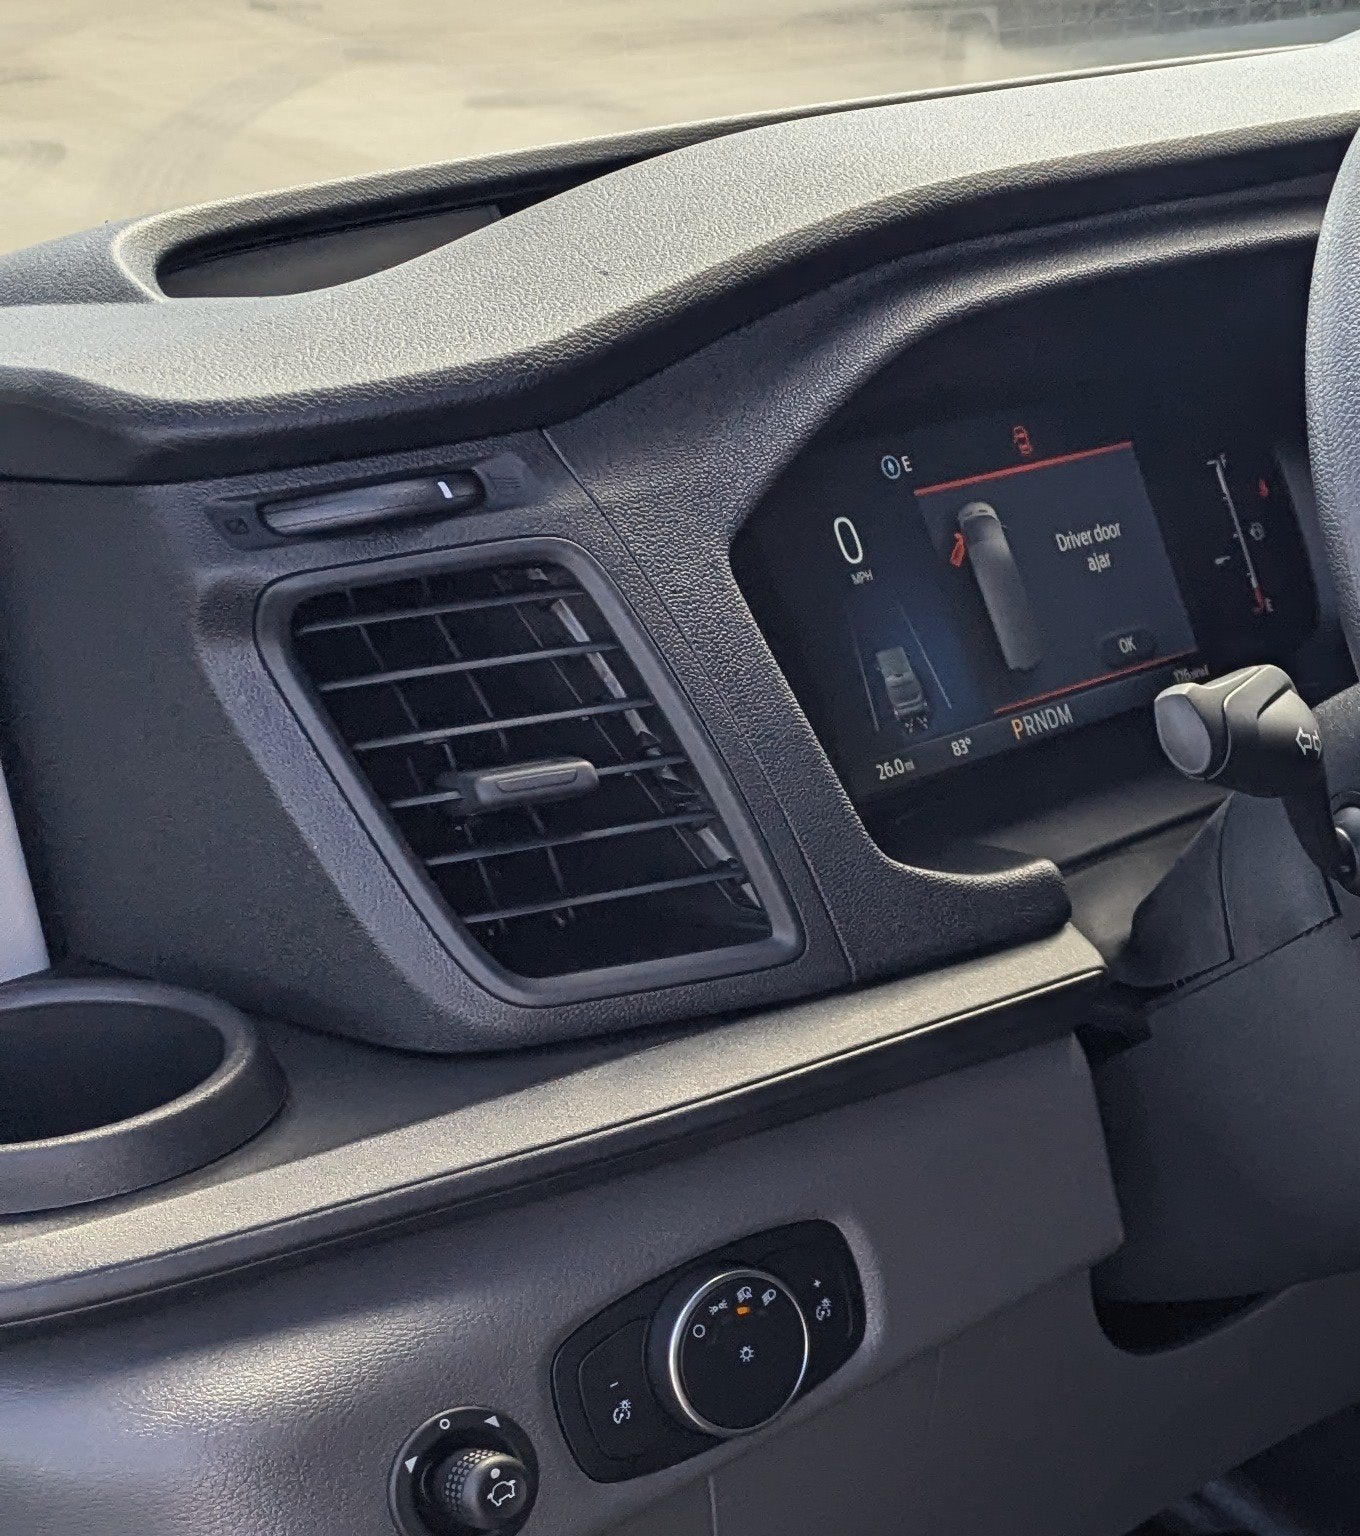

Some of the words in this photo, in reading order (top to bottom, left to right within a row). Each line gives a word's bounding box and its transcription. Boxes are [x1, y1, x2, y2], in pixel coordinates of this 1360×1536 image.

[901, 455, 913, 472] E
[833, 516, 863, 564] 0
[1055, 530, 1093, 552] Driver
[1093, 523, 1121, 542] door
[1087, 552, 1112, 573] ajar
[1119, 636, 1136, 654] OK
